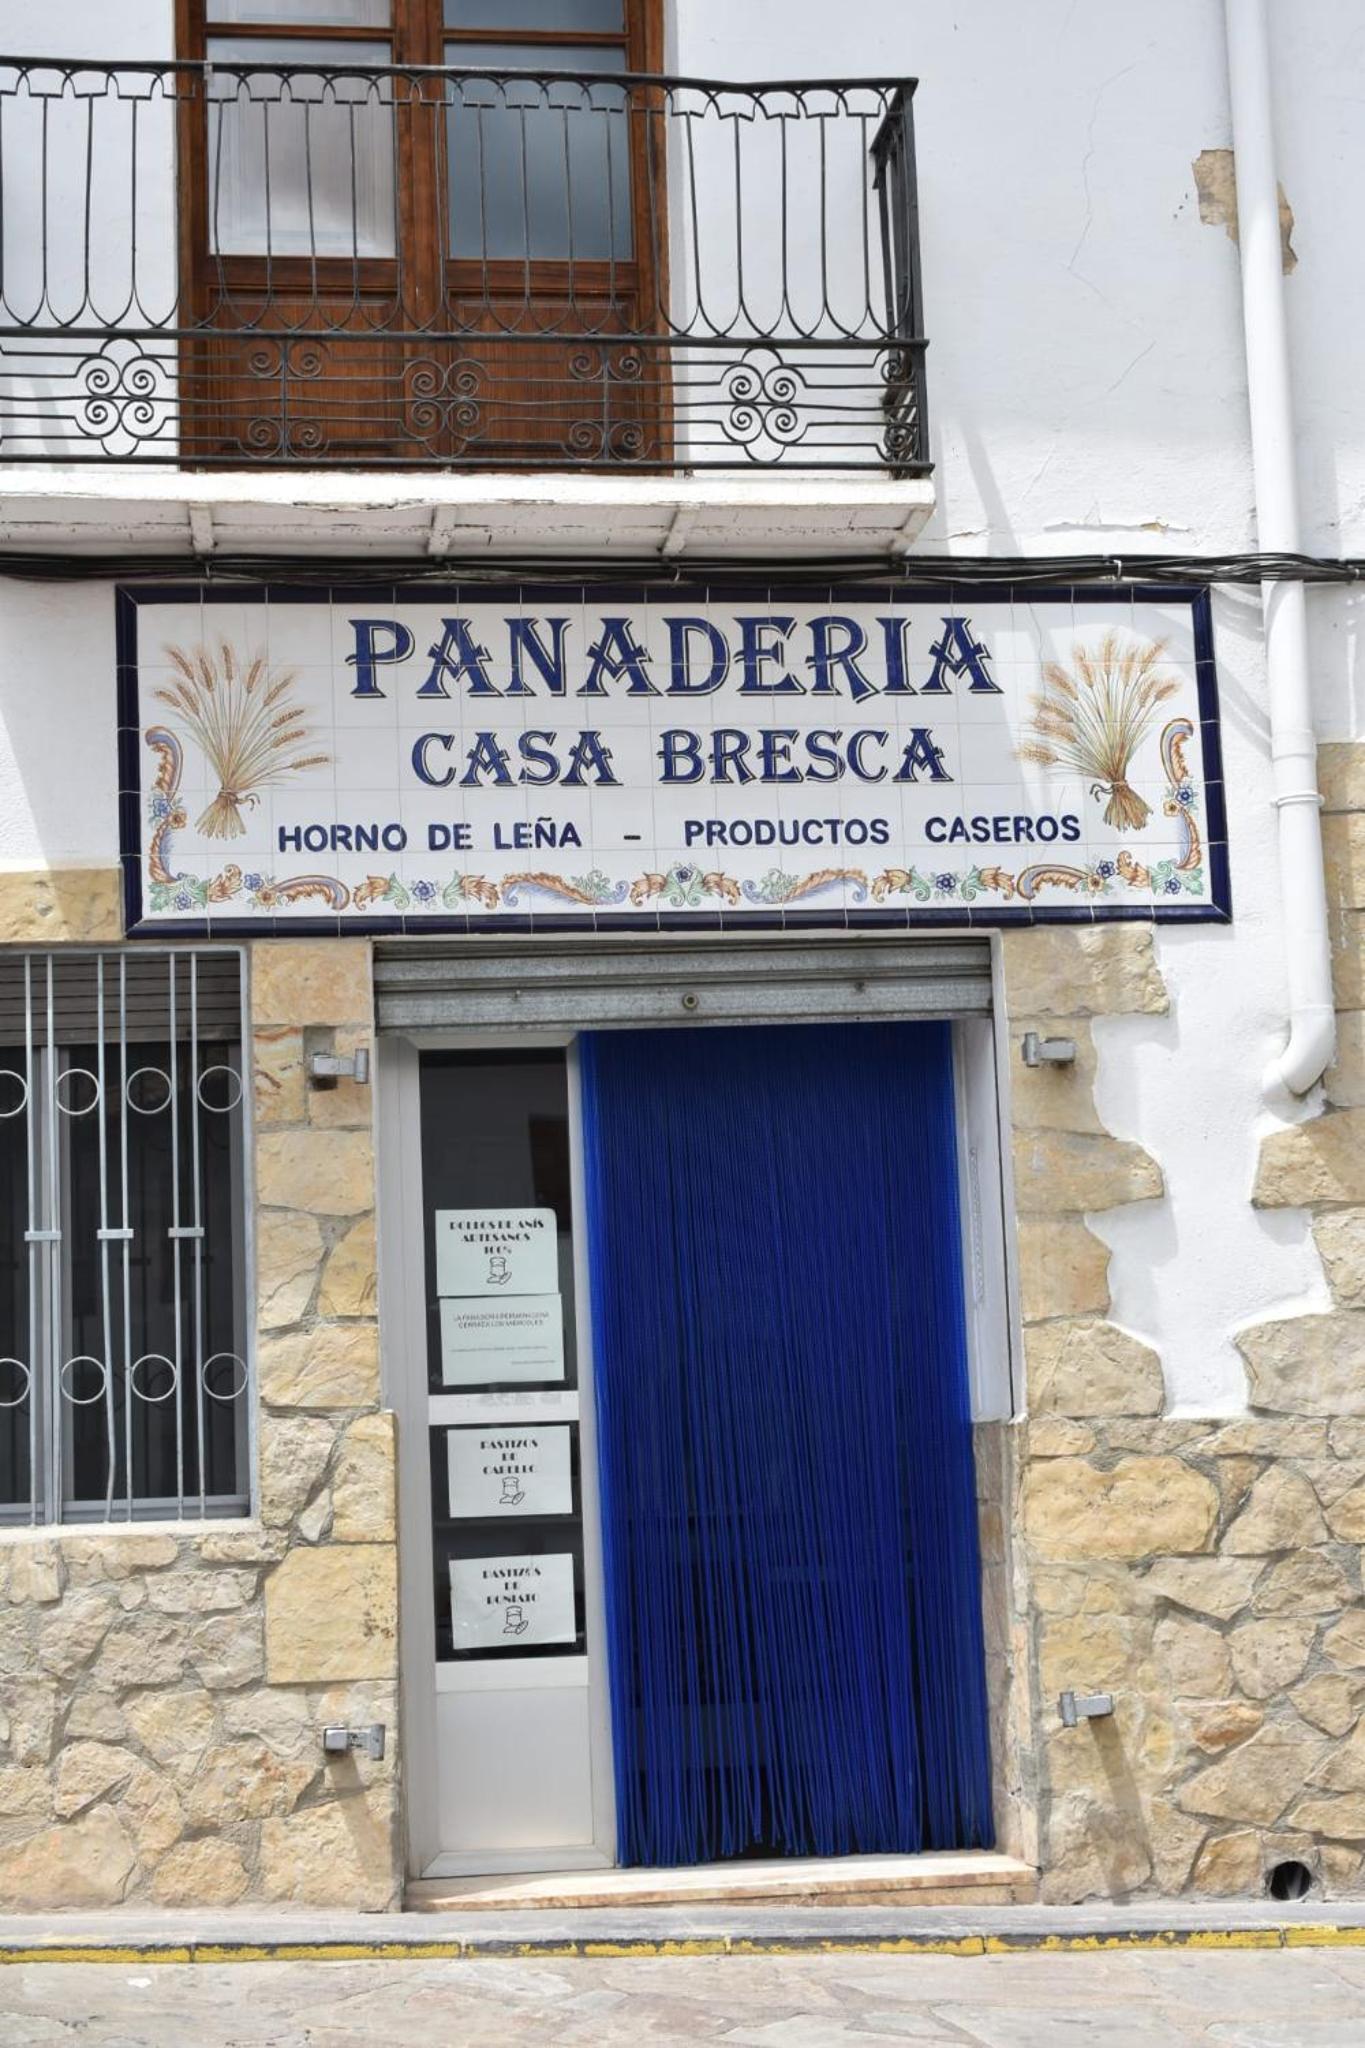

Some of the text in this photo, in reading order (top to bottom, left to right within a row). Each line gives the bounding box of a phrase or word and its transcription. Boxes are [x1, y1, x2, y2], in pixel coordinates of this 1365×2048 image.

[345, 616, 1004, 704] PANADERIA
[411, 728, 954, 788] CASA BRESCA
[278, 824, 408, 852] HORNO
[428, 823, 473, 851] DE
[493, 817, 582, 850] LEÑA
[684, 818, 889, 847] PRODUCTOS
[925, 814, 1081, 843] CASEROS
